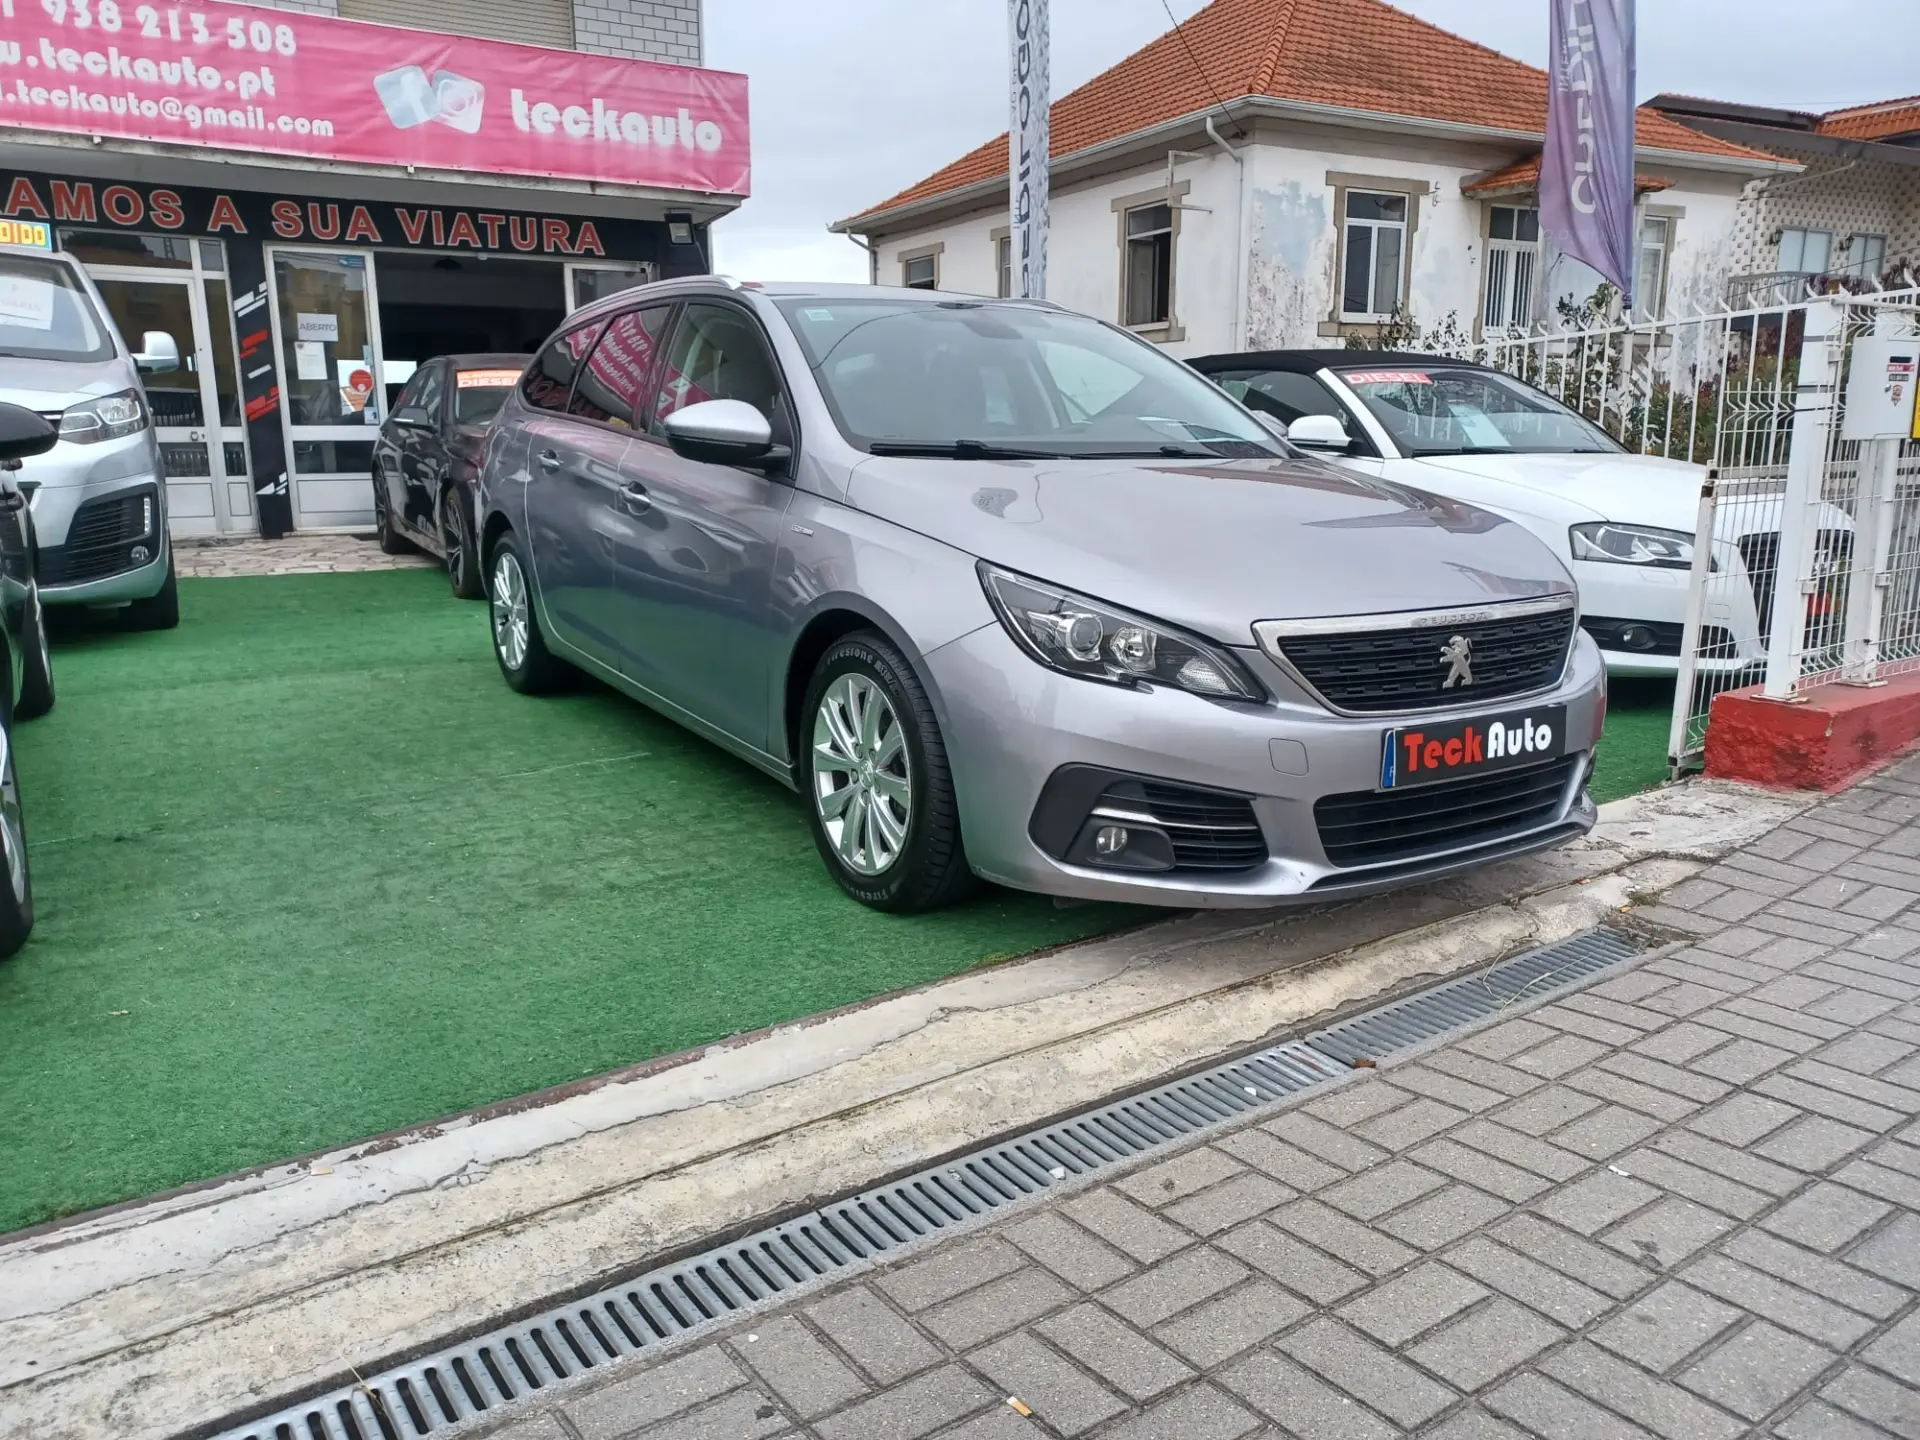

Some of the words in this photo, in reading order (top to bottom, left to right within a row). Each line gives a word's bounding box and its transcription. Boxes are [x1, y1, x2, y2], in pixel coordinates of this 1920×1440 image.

[40, 0, 122, 32] 938
[135, 5, 210, 44] 213
[227, 18, 297, 56] 508
[0, 79, 334, 137] .teckauto@gmail.com
[510, 88, 723, 152] teckauto
[0, 177, 185, 229] AMOS
[206, 195, 248, 234] A
[271, 200, 383, 242] SUA
[395, 208, 606, 256] VIATURA
[299, 322, 337, 332] ABERTO
[1344, 373, 1433, 385] DIESEL
[1420, 612, 1486, 627] PEUGEOT
[1404, 726, 1483, 772] Teck
[1487, 717, 1552, 759] Auto
